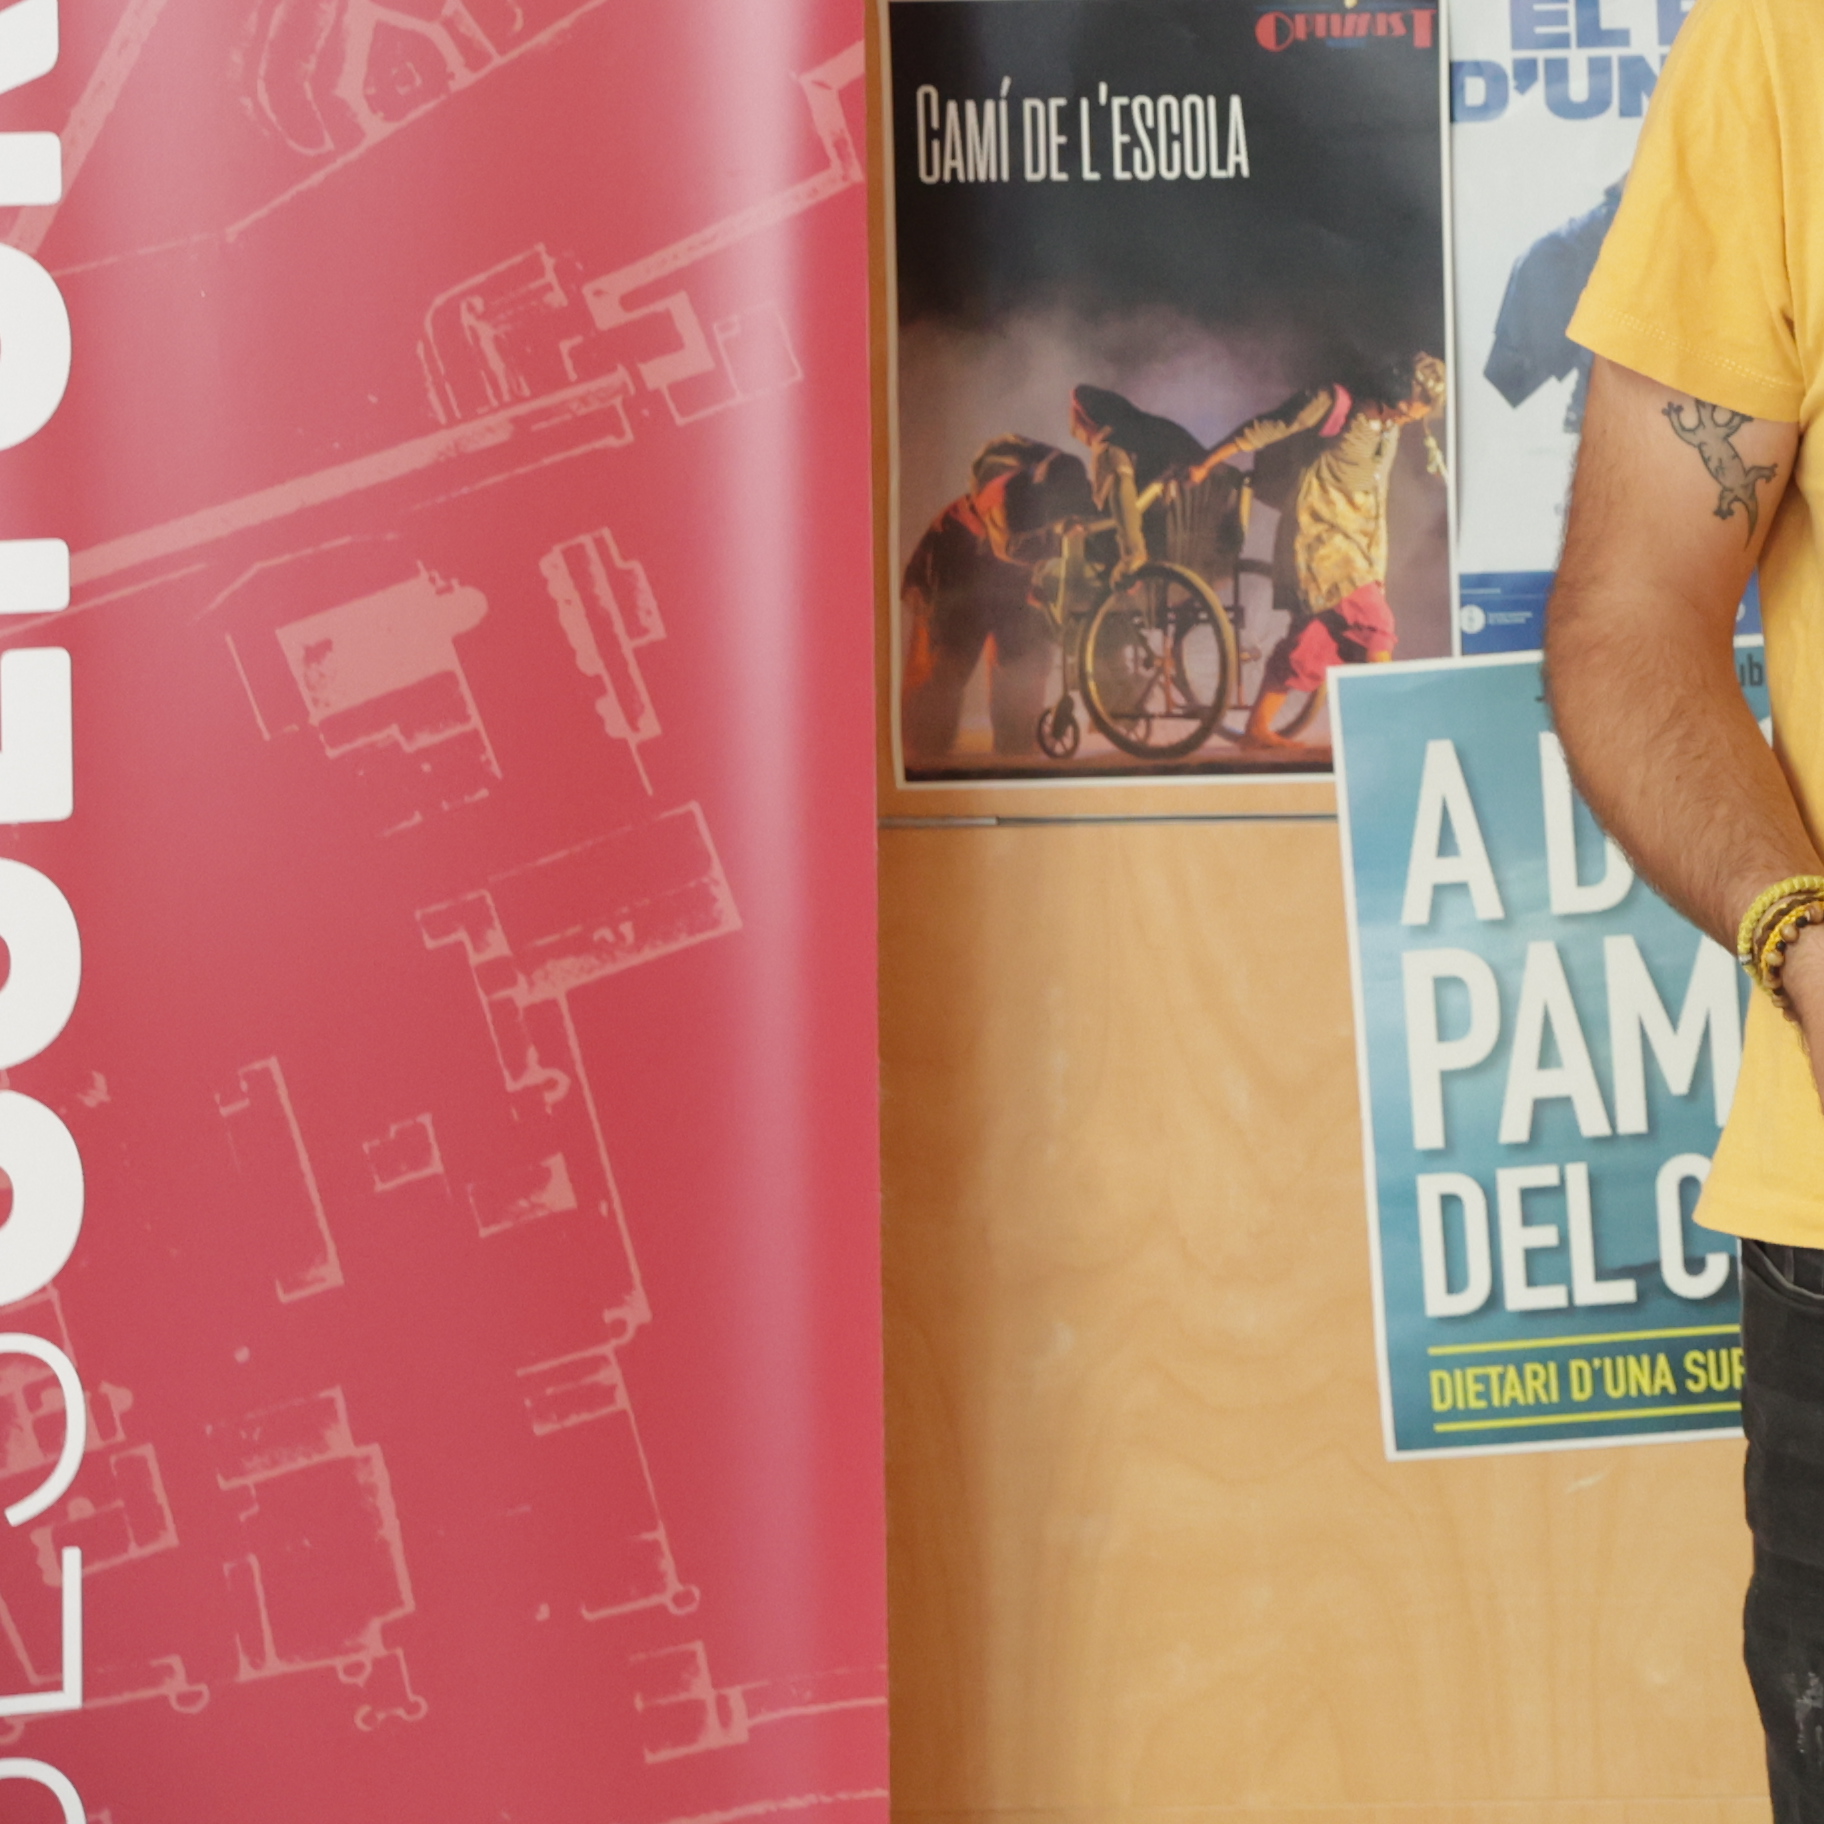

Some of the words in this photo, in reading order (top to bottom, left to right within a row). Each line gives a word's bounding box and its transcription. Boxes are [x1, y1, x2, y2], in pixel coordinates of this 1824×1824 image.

[1401, 738, 1505, 926] A
[1416, 1162, 1637, 1318] DEL
[1429, 1360, 1559, 1412] DIETARI
[1569, 1351, 1677, 1402] D'UNA
